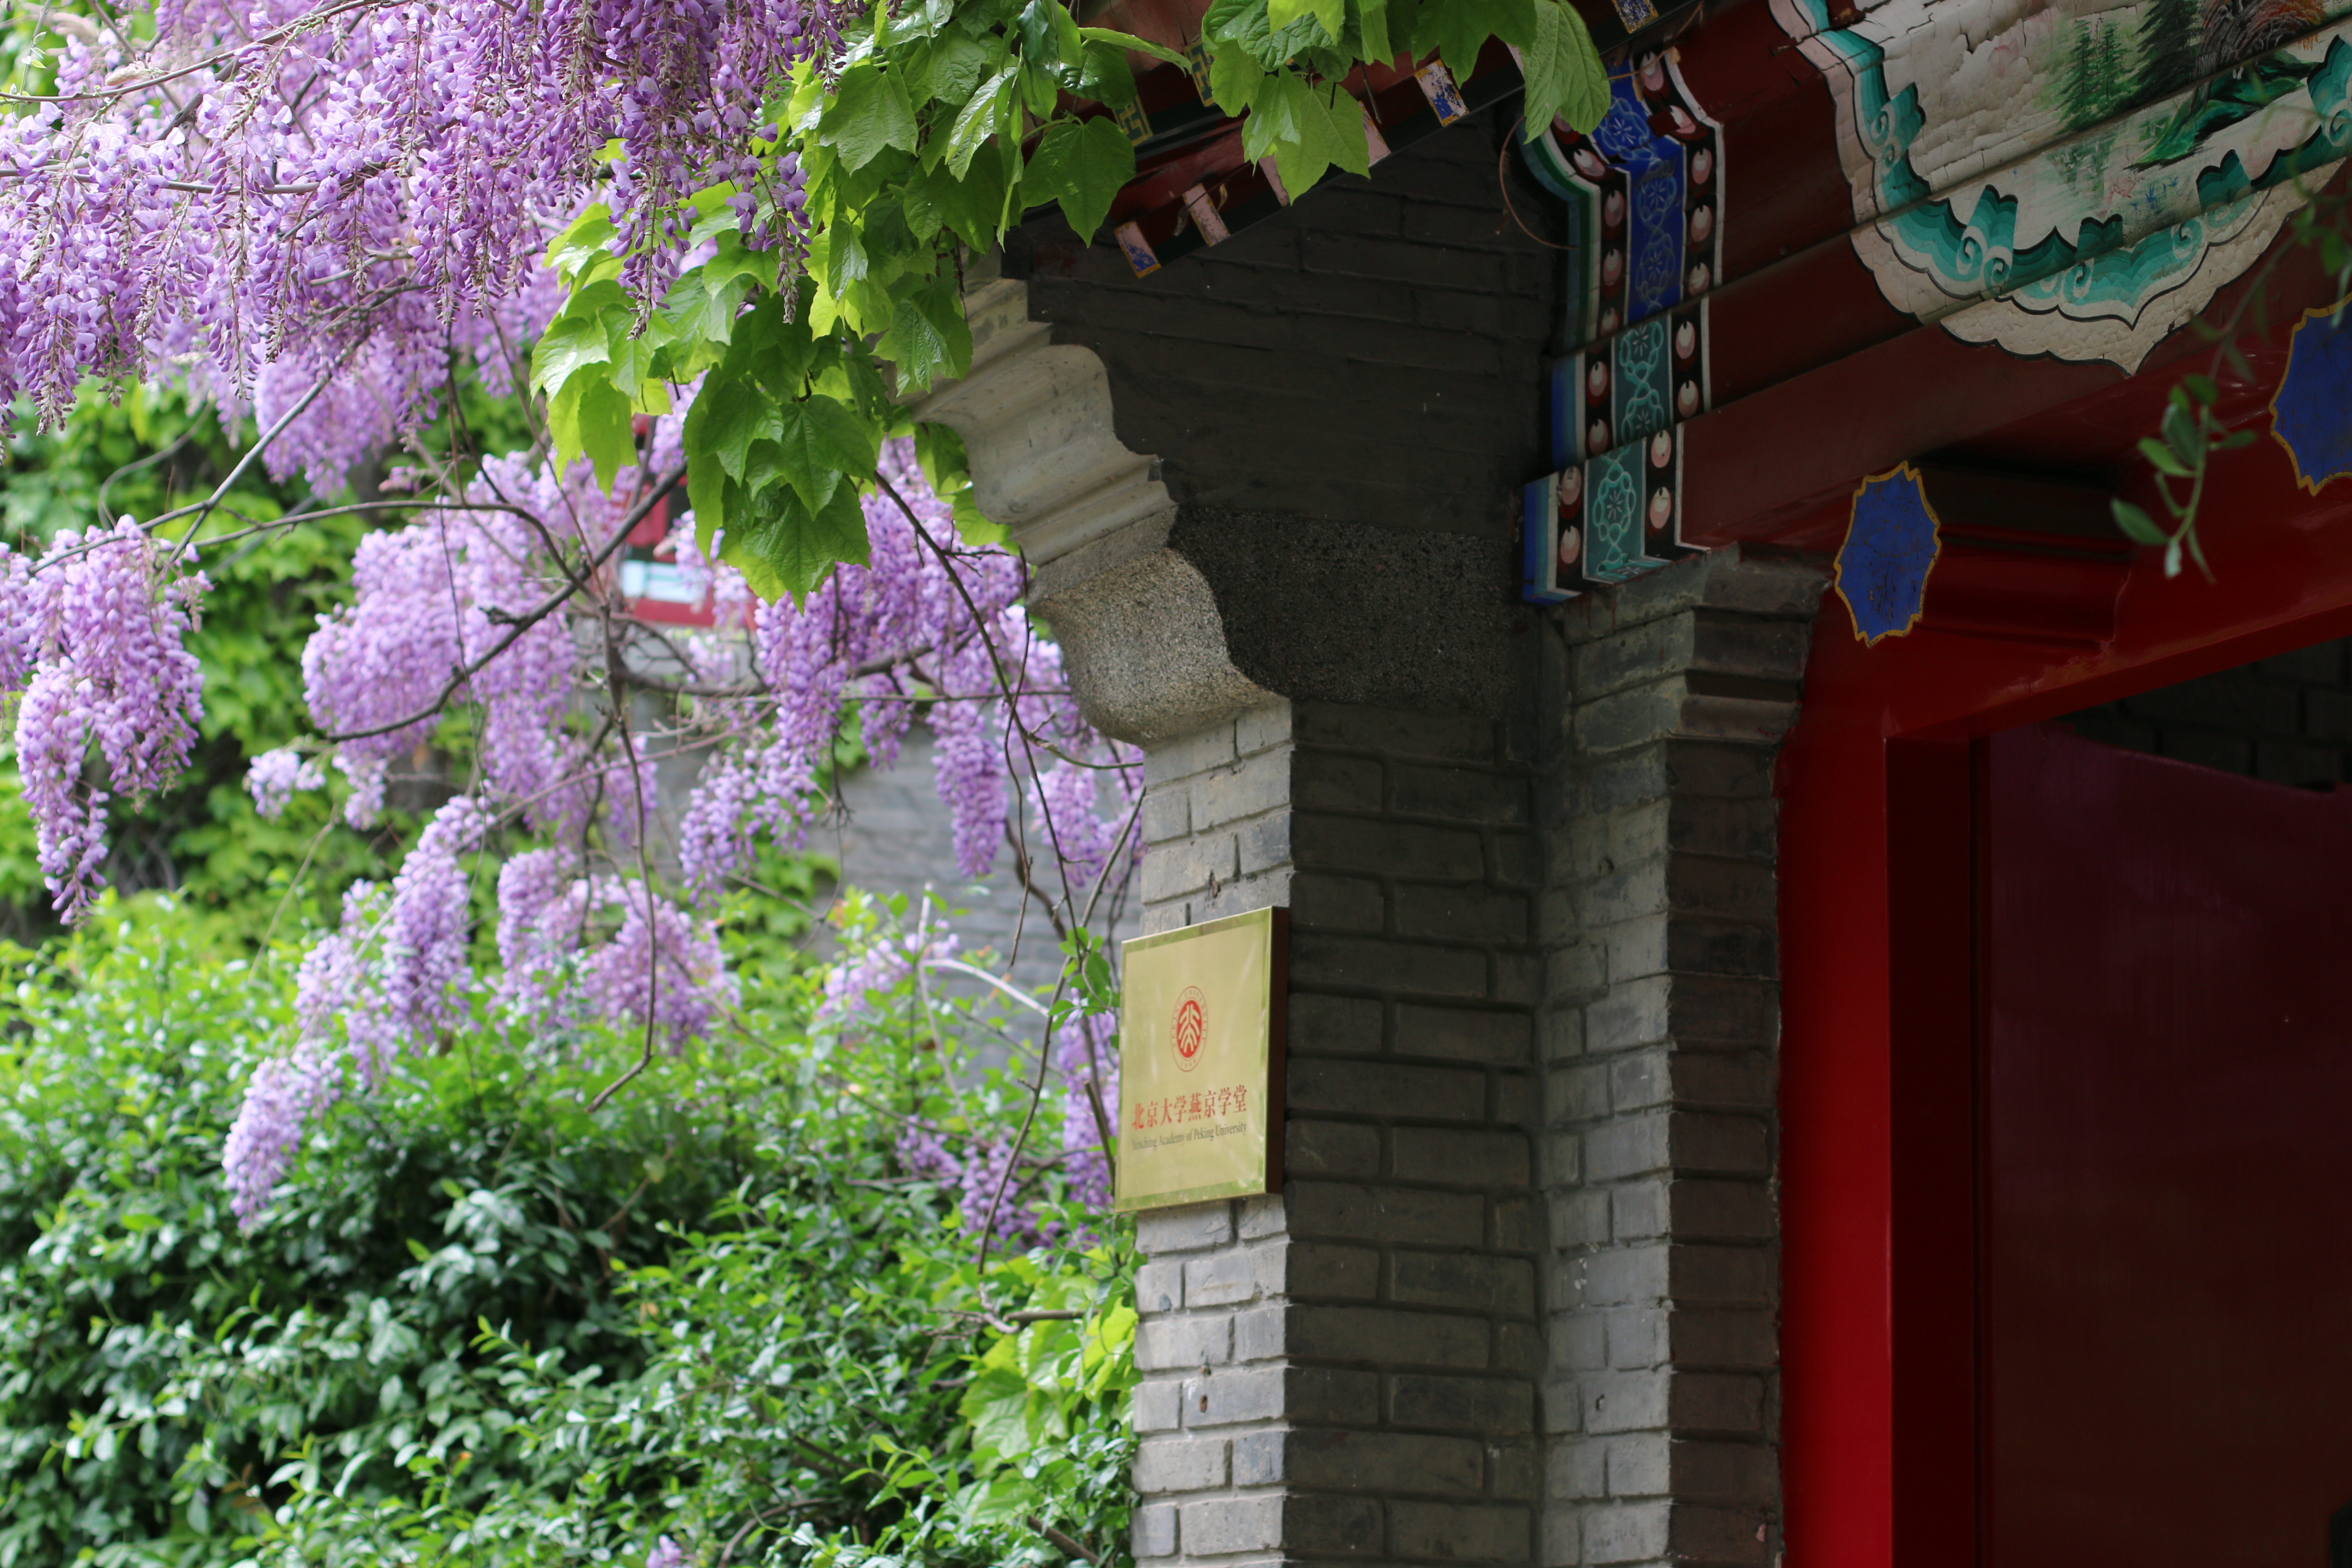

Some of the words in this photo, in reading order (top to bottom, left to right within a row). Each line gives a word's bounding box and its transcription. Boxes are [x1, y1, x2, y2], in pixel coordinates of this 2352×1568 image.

[1132, 1085, 1247, 1130] 北京大学燕京学堂
[1159, 1132, 1185, 1146] Academy
[1186, 1129, 1194, 1141] of
[1194, 1127, 1214, 1141] Peking
[1216, 1121, 1247, 1136] University
